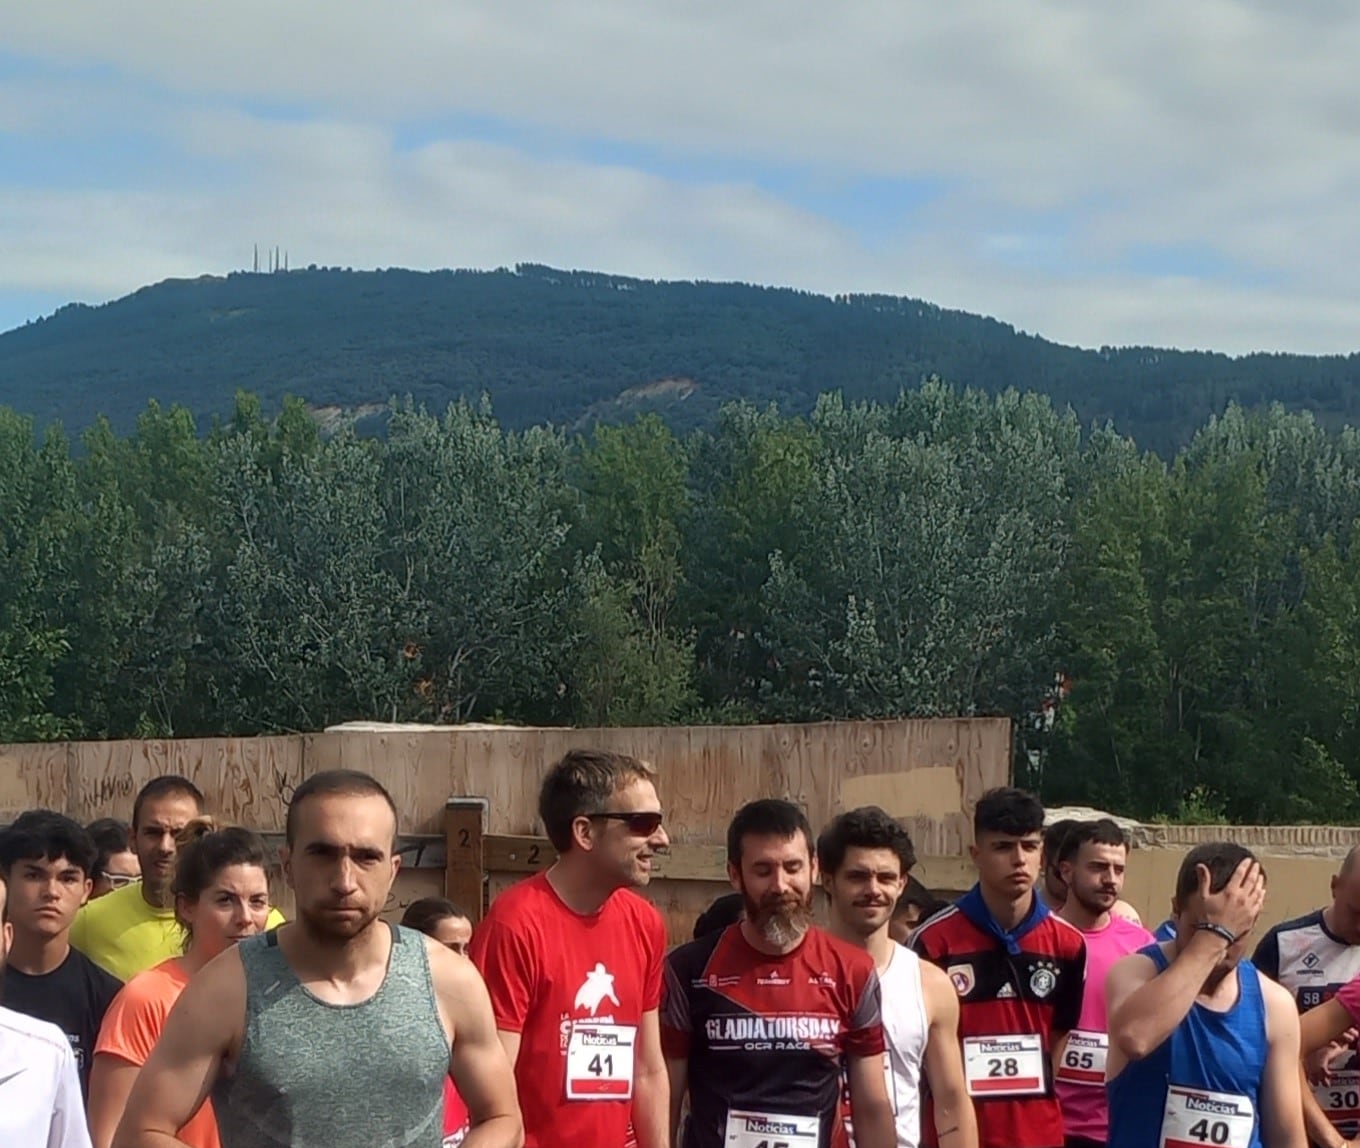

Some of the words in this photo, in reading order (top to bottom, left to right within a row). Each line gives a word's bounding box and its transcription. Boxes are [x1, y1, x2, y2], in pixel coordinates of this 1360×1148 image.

[458, 829, 471, 848] 2
[528, 845, 540, 864] 2
[705, 1016, 841, 1042] GLADIATORSDAY
[744, 1042, 772, 1050] OCR
[775, 1042, 810, 1050] RACE
[588, 1054, 614, 1077] 41
[988, 1058, 1019, 1077] 28
[1065, 1050, 1094, 1069] 65
[1187, 1098, 1236, 1115] Noticias
[1329, 1091, 1359, 1108] 30
[747, 1120, 796, 1135] Noticias
[1189, 1119, 1229, 1145] 40
